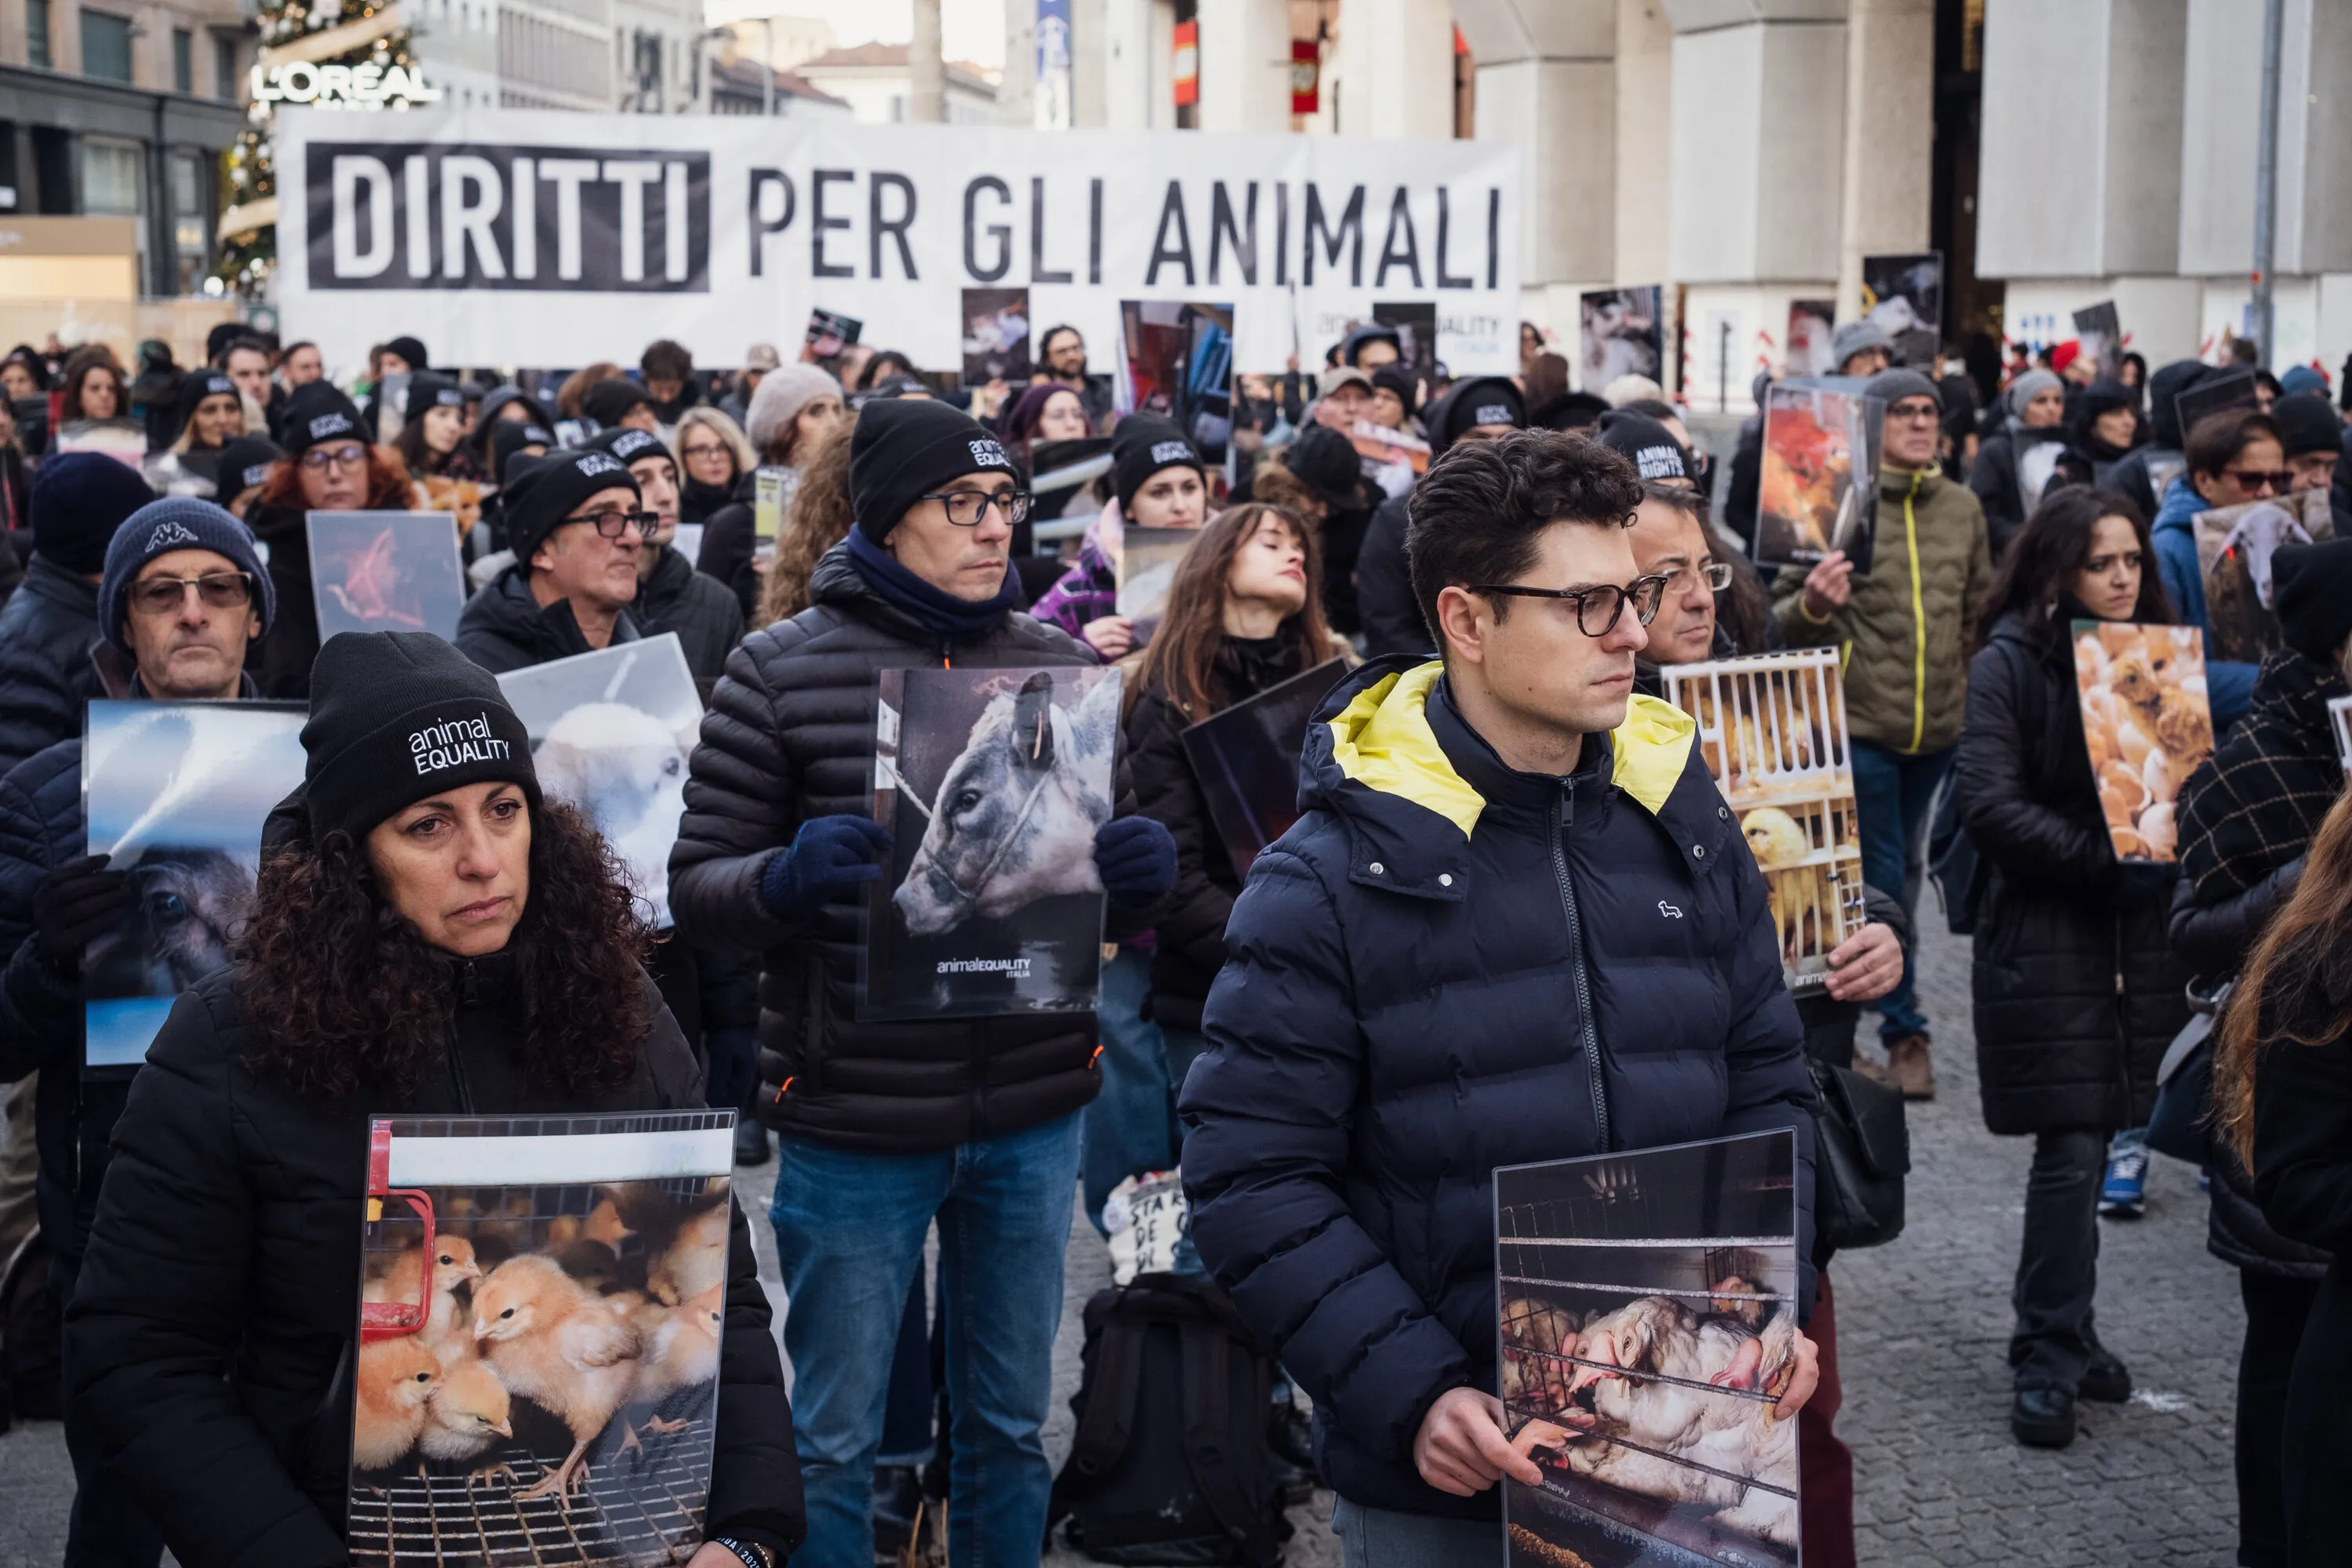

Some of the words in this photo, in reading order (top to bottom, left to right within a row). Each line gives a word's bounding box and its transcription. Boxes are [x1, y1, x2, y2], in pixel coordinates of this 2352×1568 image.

[332, 155, 688, 282] DIRITTI
[749, 169, 919, 280] PER
[964, 174, 1103, 285] GLI
[1145, 180, 1500, 289] ANIMALI
[1636, 445, 1679, 464] ANIMAL
[408, 712, 492, 753] animal
[414, 739, 510, 775] EQUALITY
[1006, 970, 1031, 978] ITALIA
